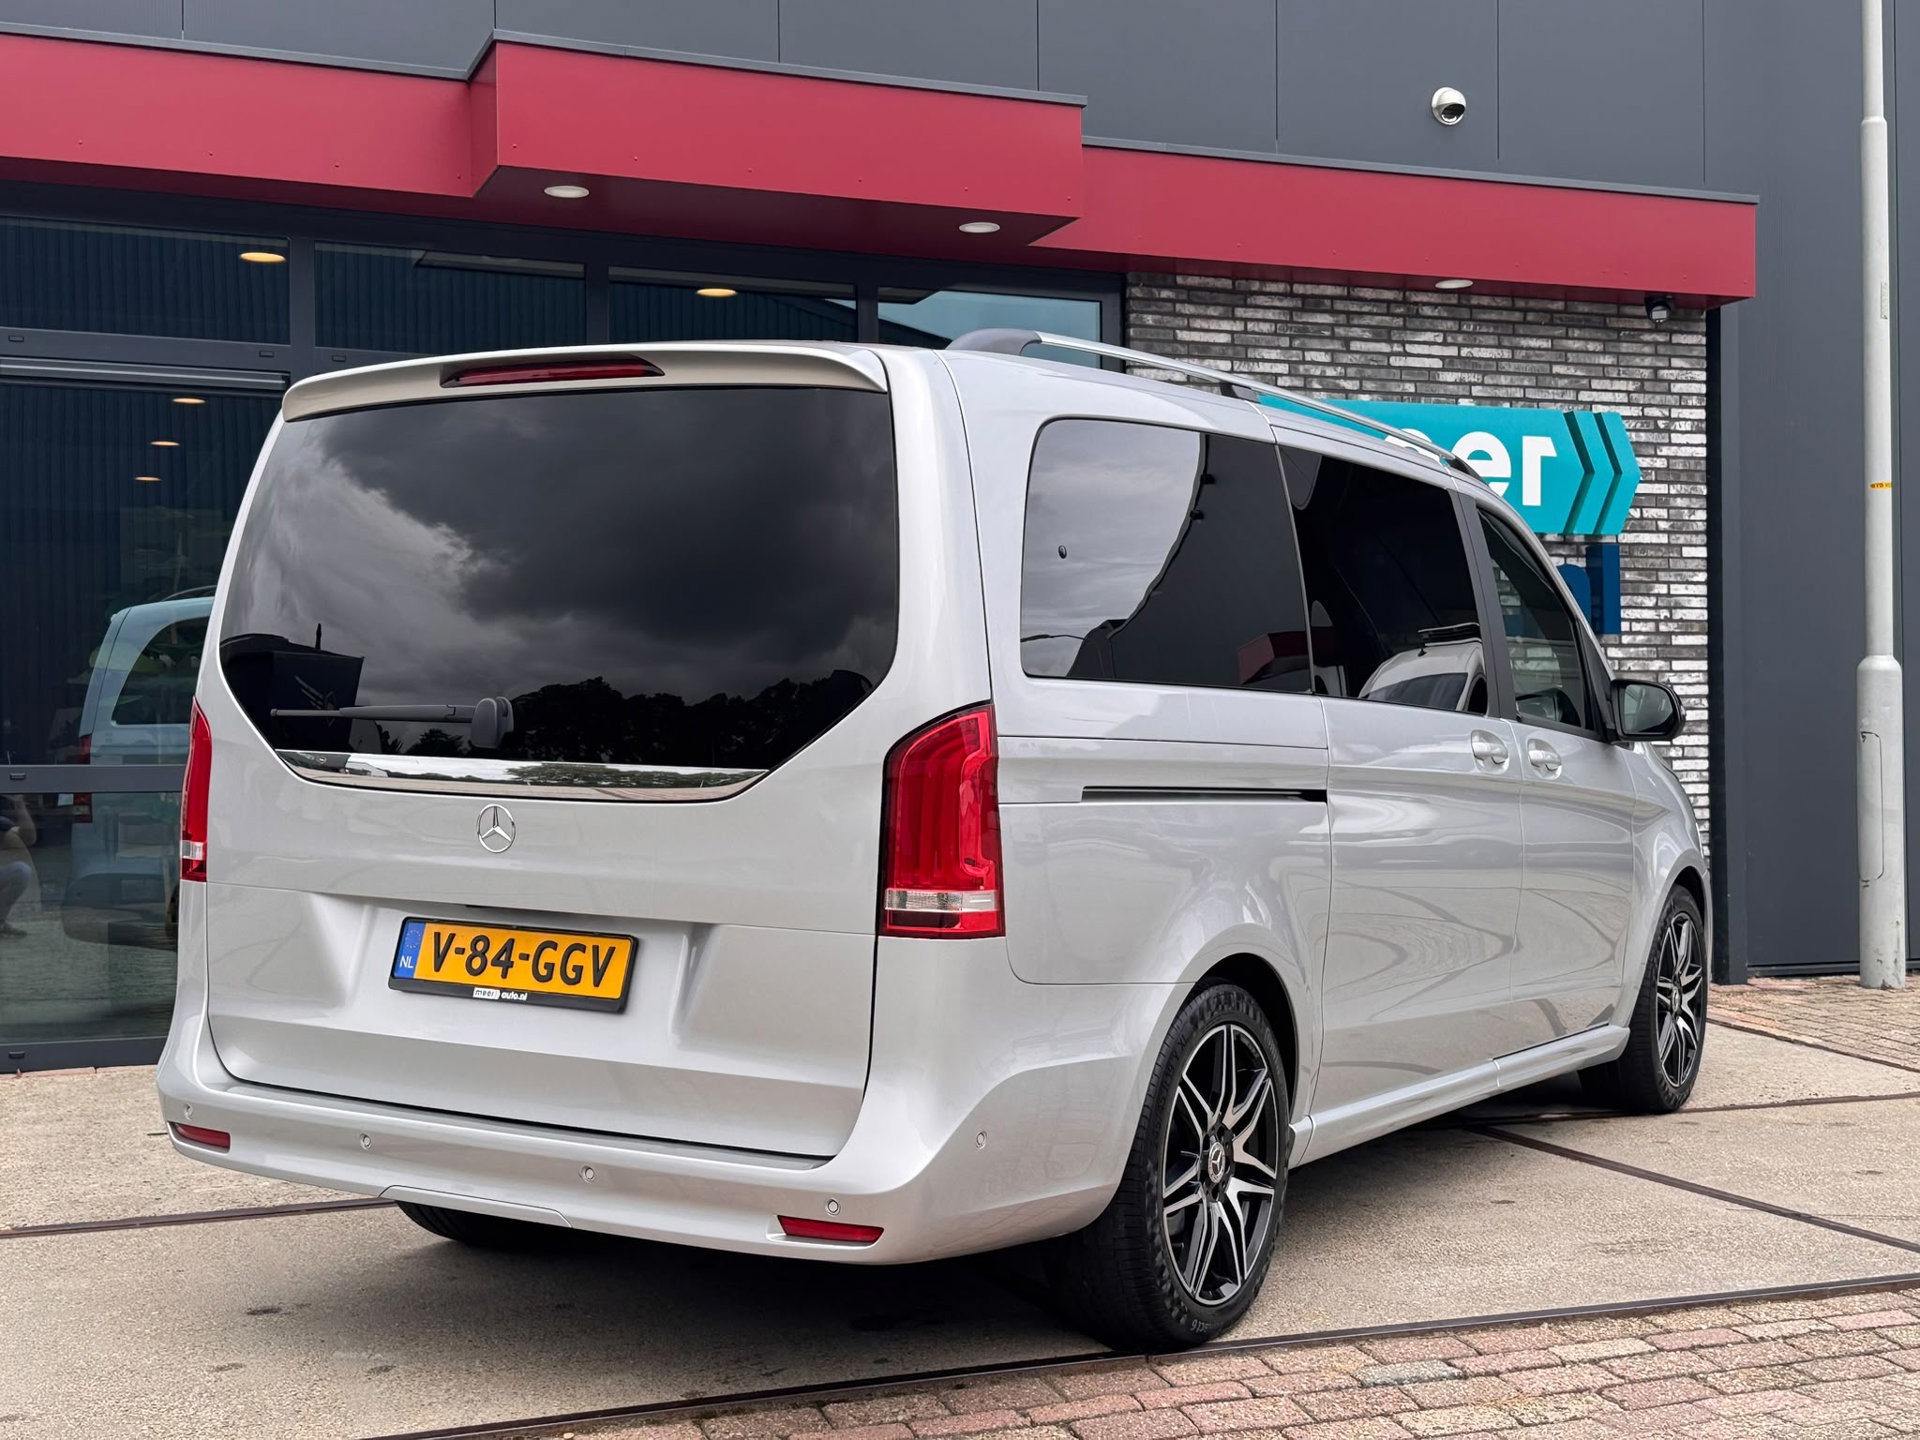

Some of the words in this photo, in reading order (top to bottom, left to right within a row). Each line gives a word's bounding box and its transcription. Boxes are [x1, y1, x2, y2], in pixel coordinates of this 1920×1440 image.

[399, 955, 414, 969] NL
[433, 932, 616, 987] V-84-GGV
[501, 991, 528, 1001] auto.nl
